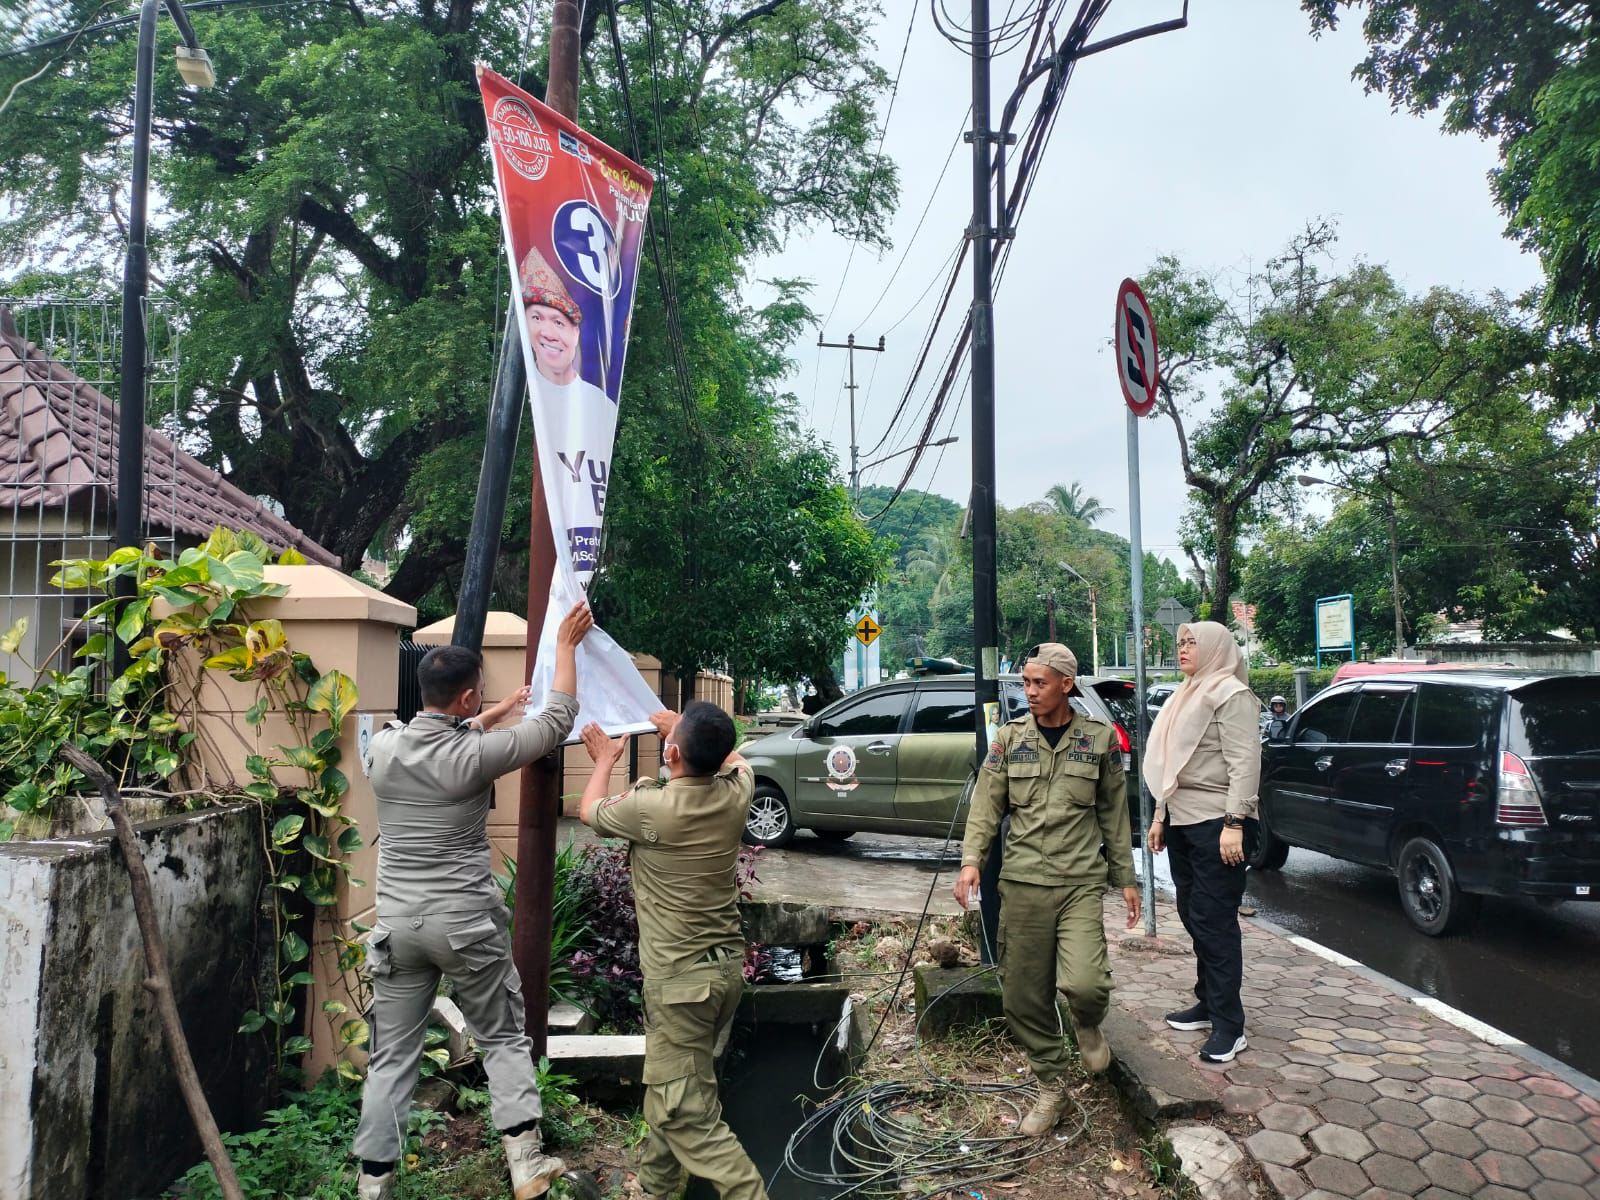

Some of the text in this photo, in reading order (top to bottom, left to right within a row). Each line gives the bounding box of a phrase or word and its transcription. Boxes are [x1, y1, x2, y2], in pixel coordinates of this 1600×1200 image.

[502, 125, 532, 148] 50-100
[533, 136, 553, 153] JUTA
[523, 156, 544, 174] TAHUN
[570, 207, 609, 290] 3
[557, 450, 606, 484] Yu
